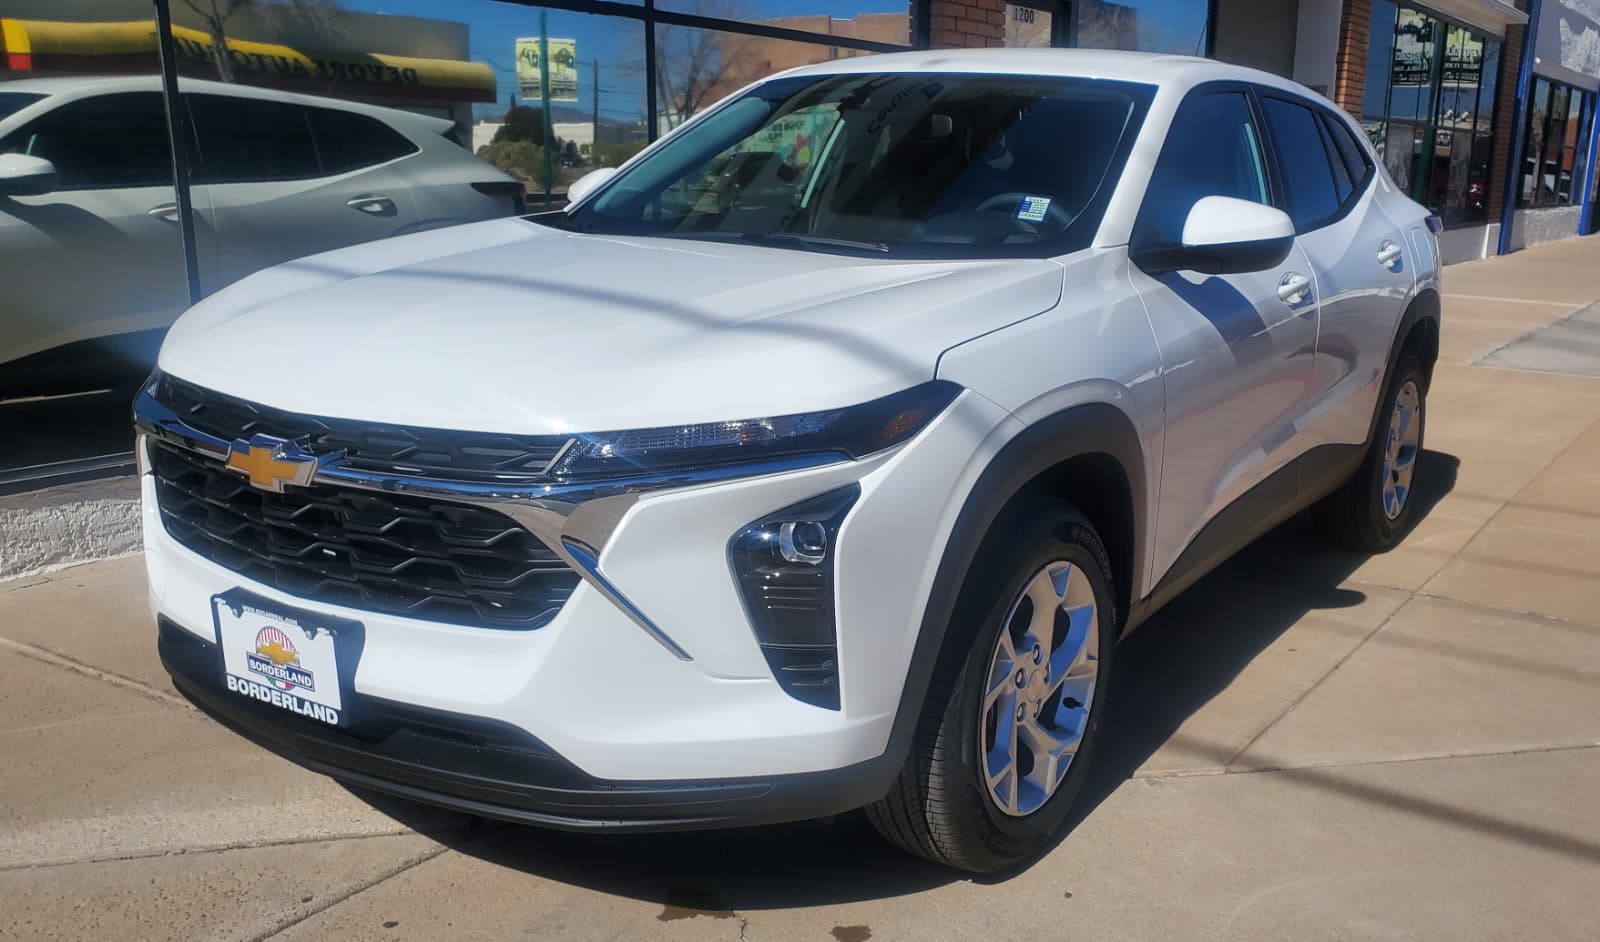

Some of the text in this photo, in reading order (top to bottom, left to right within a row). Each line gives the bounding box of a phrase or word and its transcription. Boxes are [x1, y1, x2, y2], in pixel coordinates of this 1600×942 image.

[1014, 8, 1034, 23] 1200
[249, 660, 312, 686] BORDERLAND
[227, 675, 338, 724] BORDERLAND
